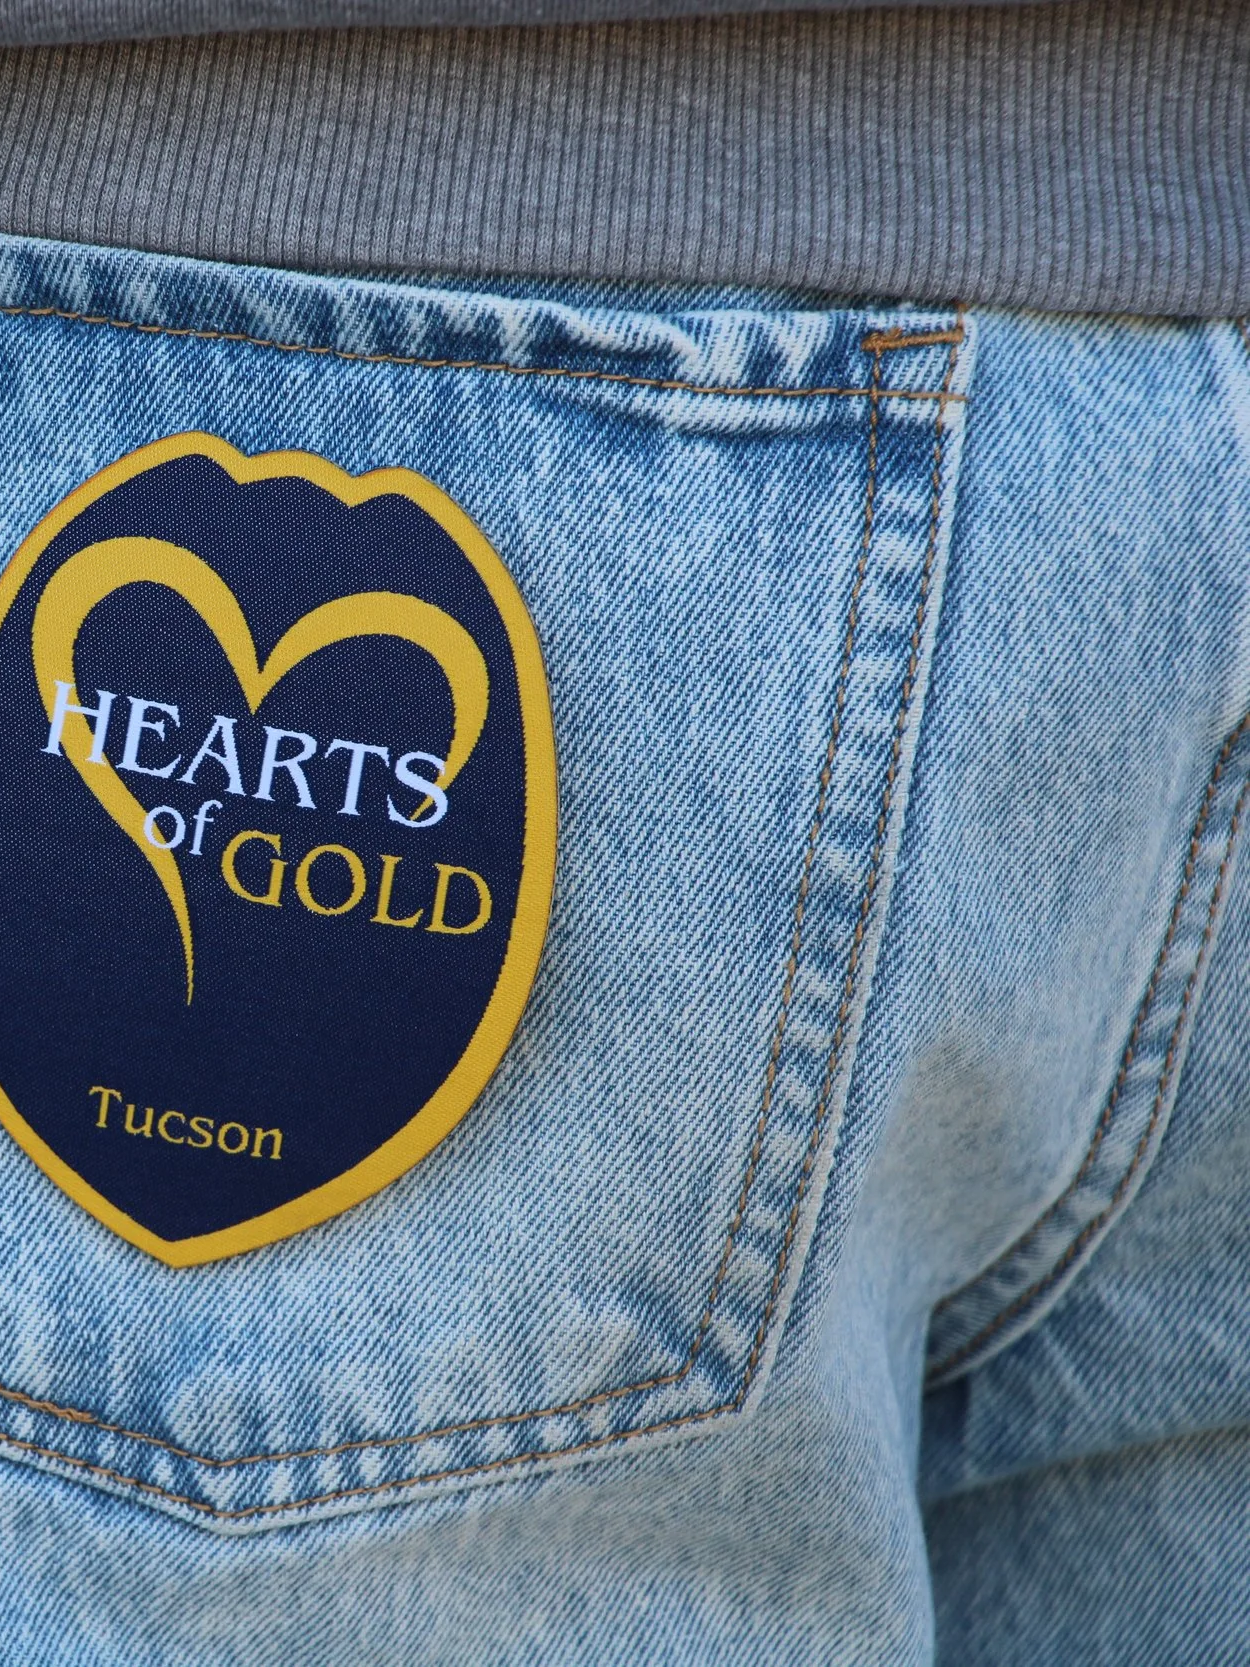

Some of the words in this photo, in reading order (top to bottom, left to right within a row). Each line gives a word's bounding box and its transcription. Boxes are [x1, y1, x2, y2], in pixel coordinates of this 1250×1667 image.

[40, 679, 449, 828] HEARTS
[142, 799, 224, 856] of
[221, 830, 493, 935] GOLD
[88, 1085, 285, 1161] Tucson
